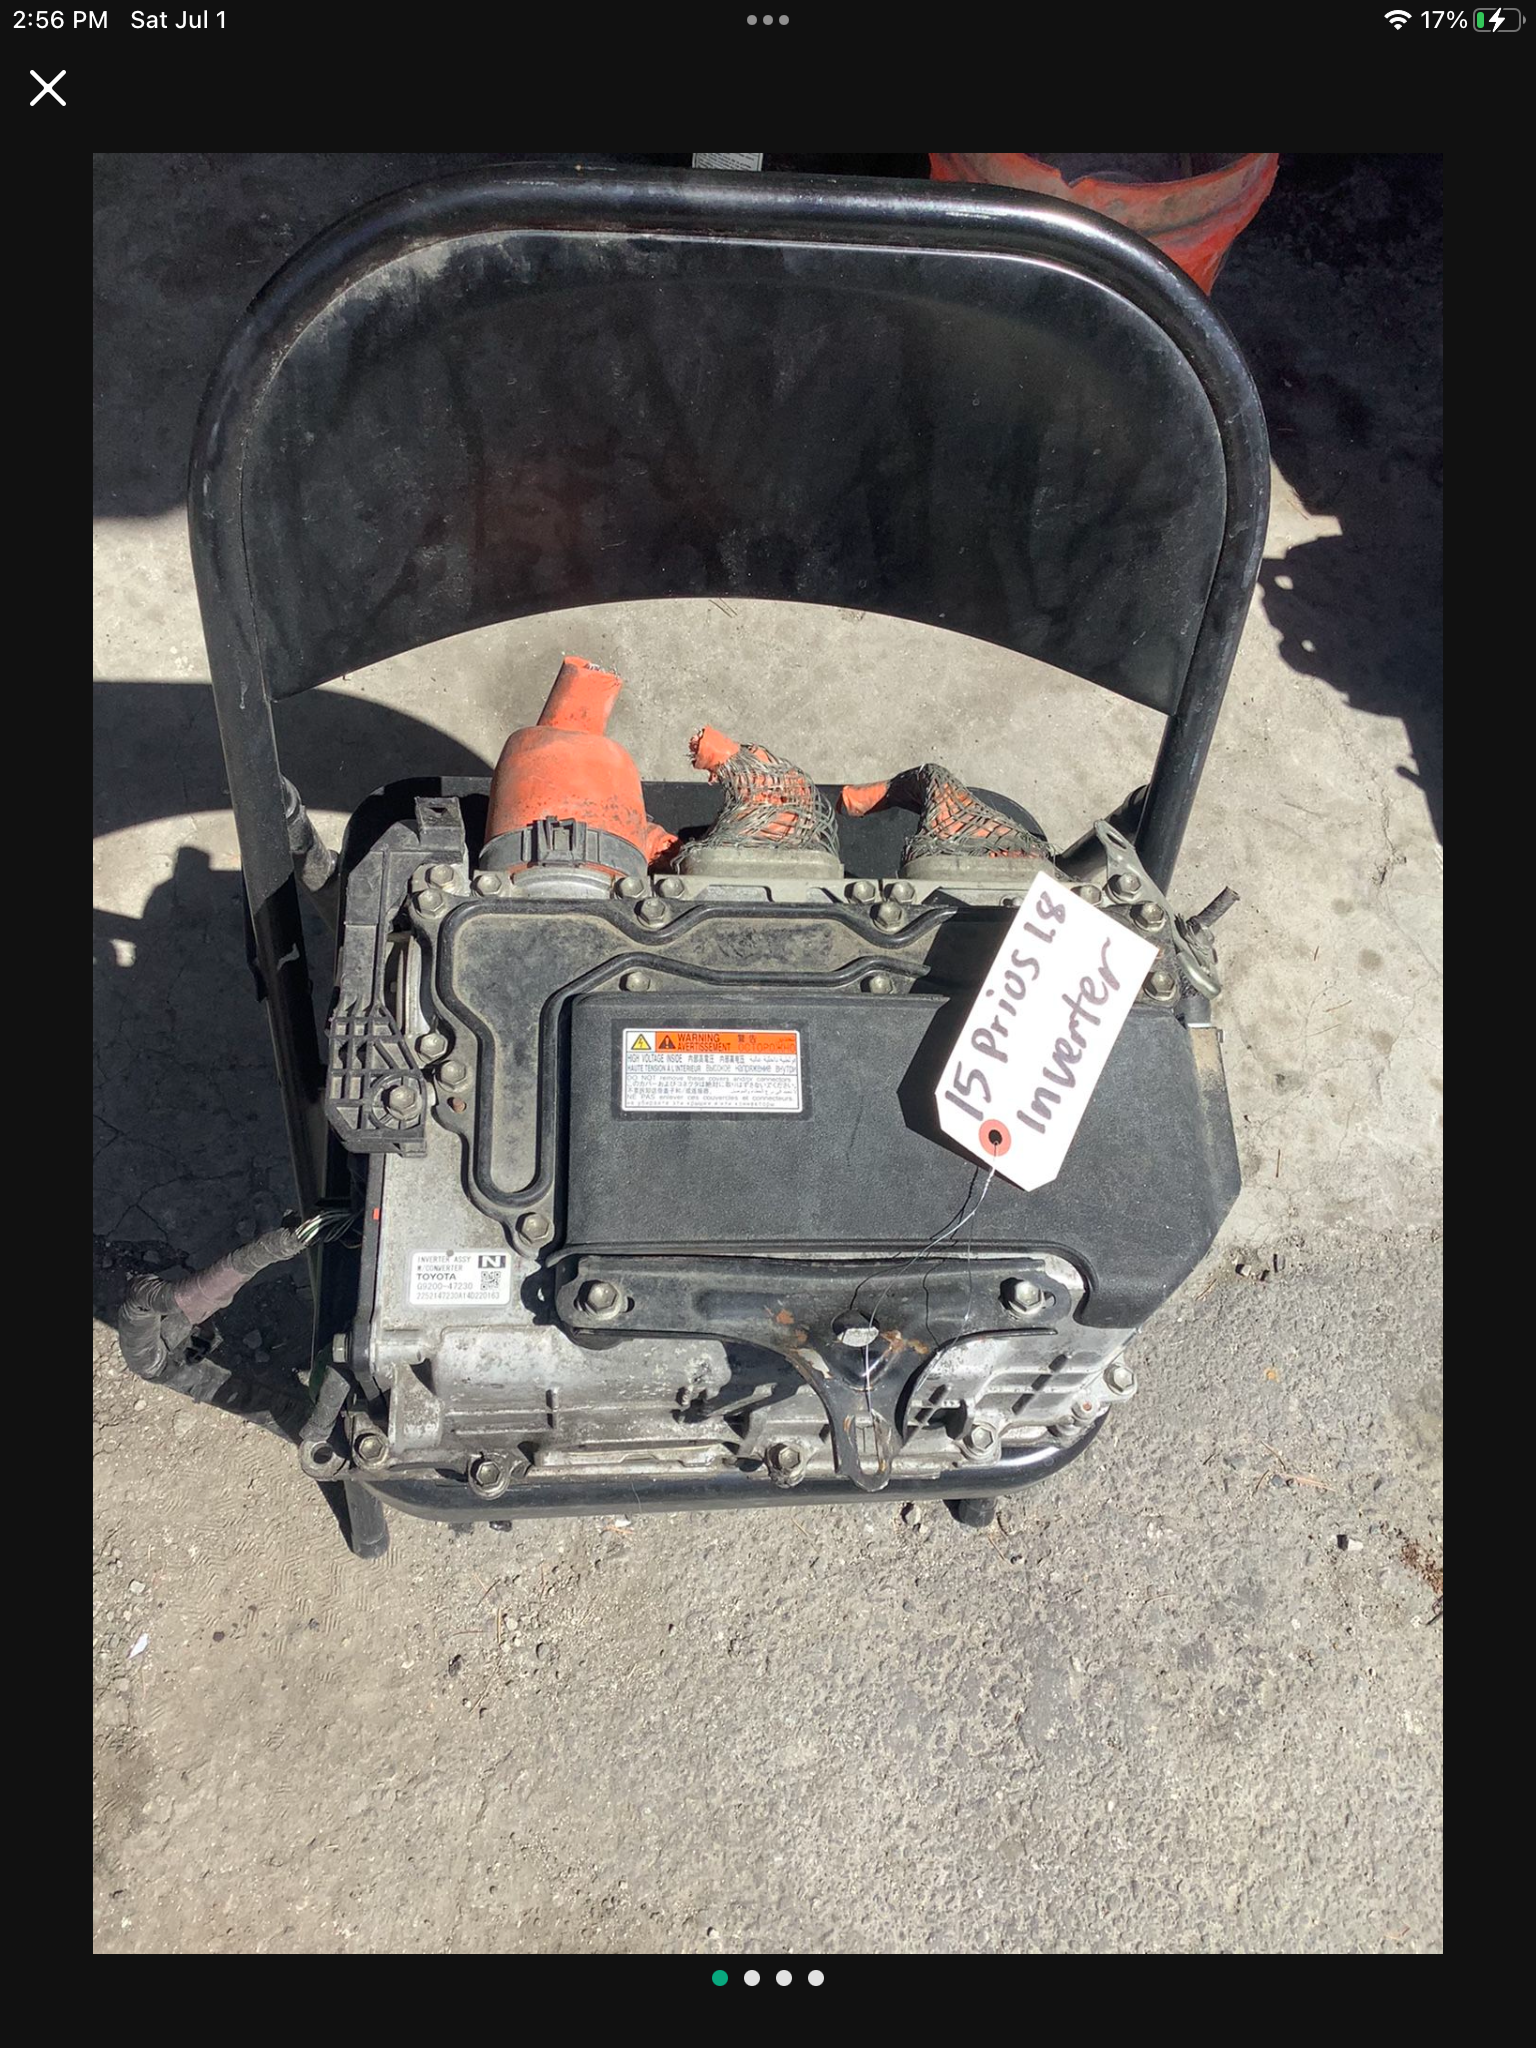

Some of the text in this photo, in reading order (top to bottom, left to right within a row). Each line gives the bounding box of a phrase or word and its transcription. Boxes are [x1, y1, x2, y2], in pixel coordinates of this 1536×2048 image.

[678, 1033, 720, 1042] WARNING
[678, 1042, 731, 1051] AVERTISSEMENT
[627, 1054, 683, 1063] HIGH VOLTAGE INSIDE
[627, 1064, 644, 1072] HAUTE
[645, 1064, 667, 1072] TENSION
[945, 1060, 991, 1121] 15
[416, 1273, 456, 1281] TOYOTA
[416, 1282, 474, 1290] G9200-47230
